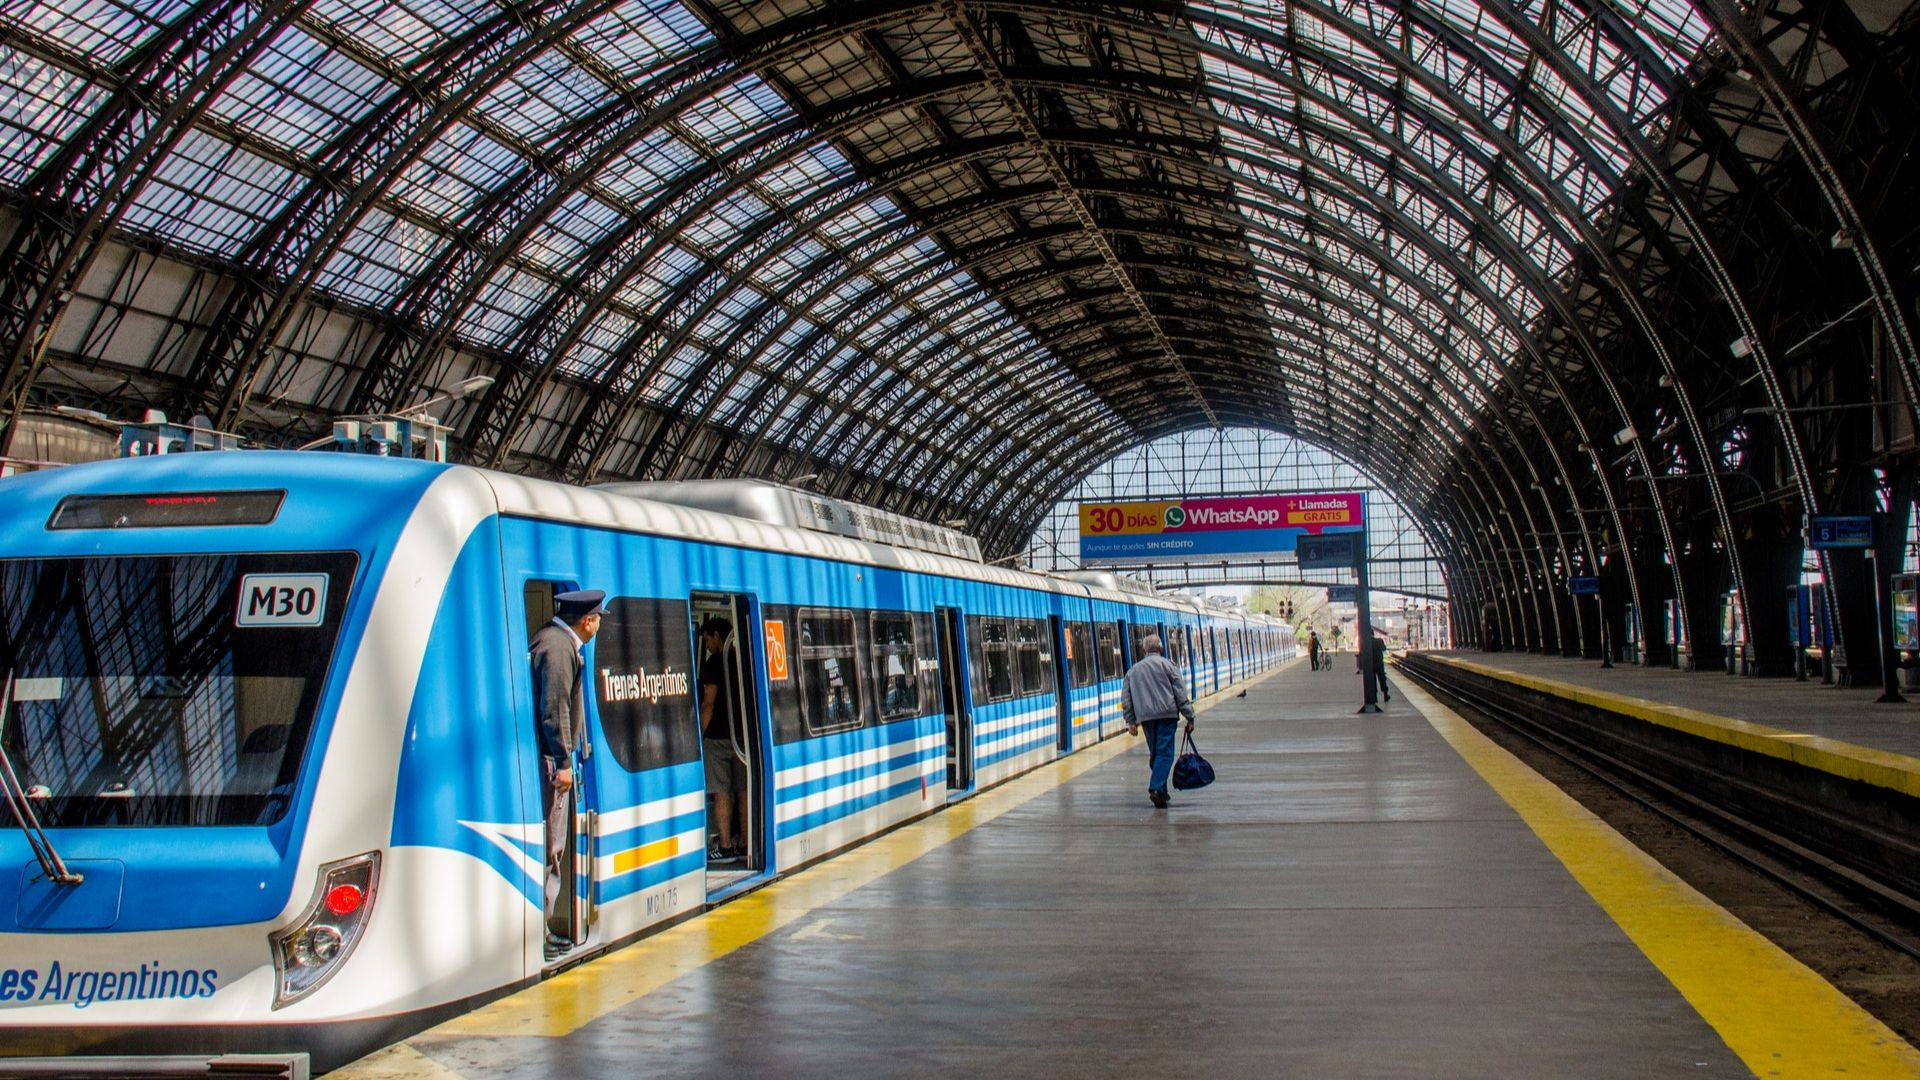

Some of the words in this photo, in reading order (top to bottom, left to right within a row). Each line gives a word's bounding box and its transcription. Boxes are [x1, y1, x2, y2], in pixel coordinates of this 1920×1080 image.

[1299, 498, 1348, 510] Llamadas
[1089, 507, 1124, 533] 30
[1127, 512, 1157, 528] DÍAS
[1188, 506, 1280, 525] WhatsApp
[1303, 511, 1342, 522] GRATIS
[1821, 528, 1830, 541] 5
[1087, 543, 1112, 553] Aunque
[1113, 543, 1121, 551] te
[1121, 542, 1145, 551] quedes
[1146, 541, 1159, 550] SIN
[1160, 539, 1195, 549] CRÉDITO
[247, 585, 317, 617] M30
[602, 668, 640, 701] Trenes
[640, 666, 688, 704] Argentinos
[38, 960, 219, 1009] Argentinos
